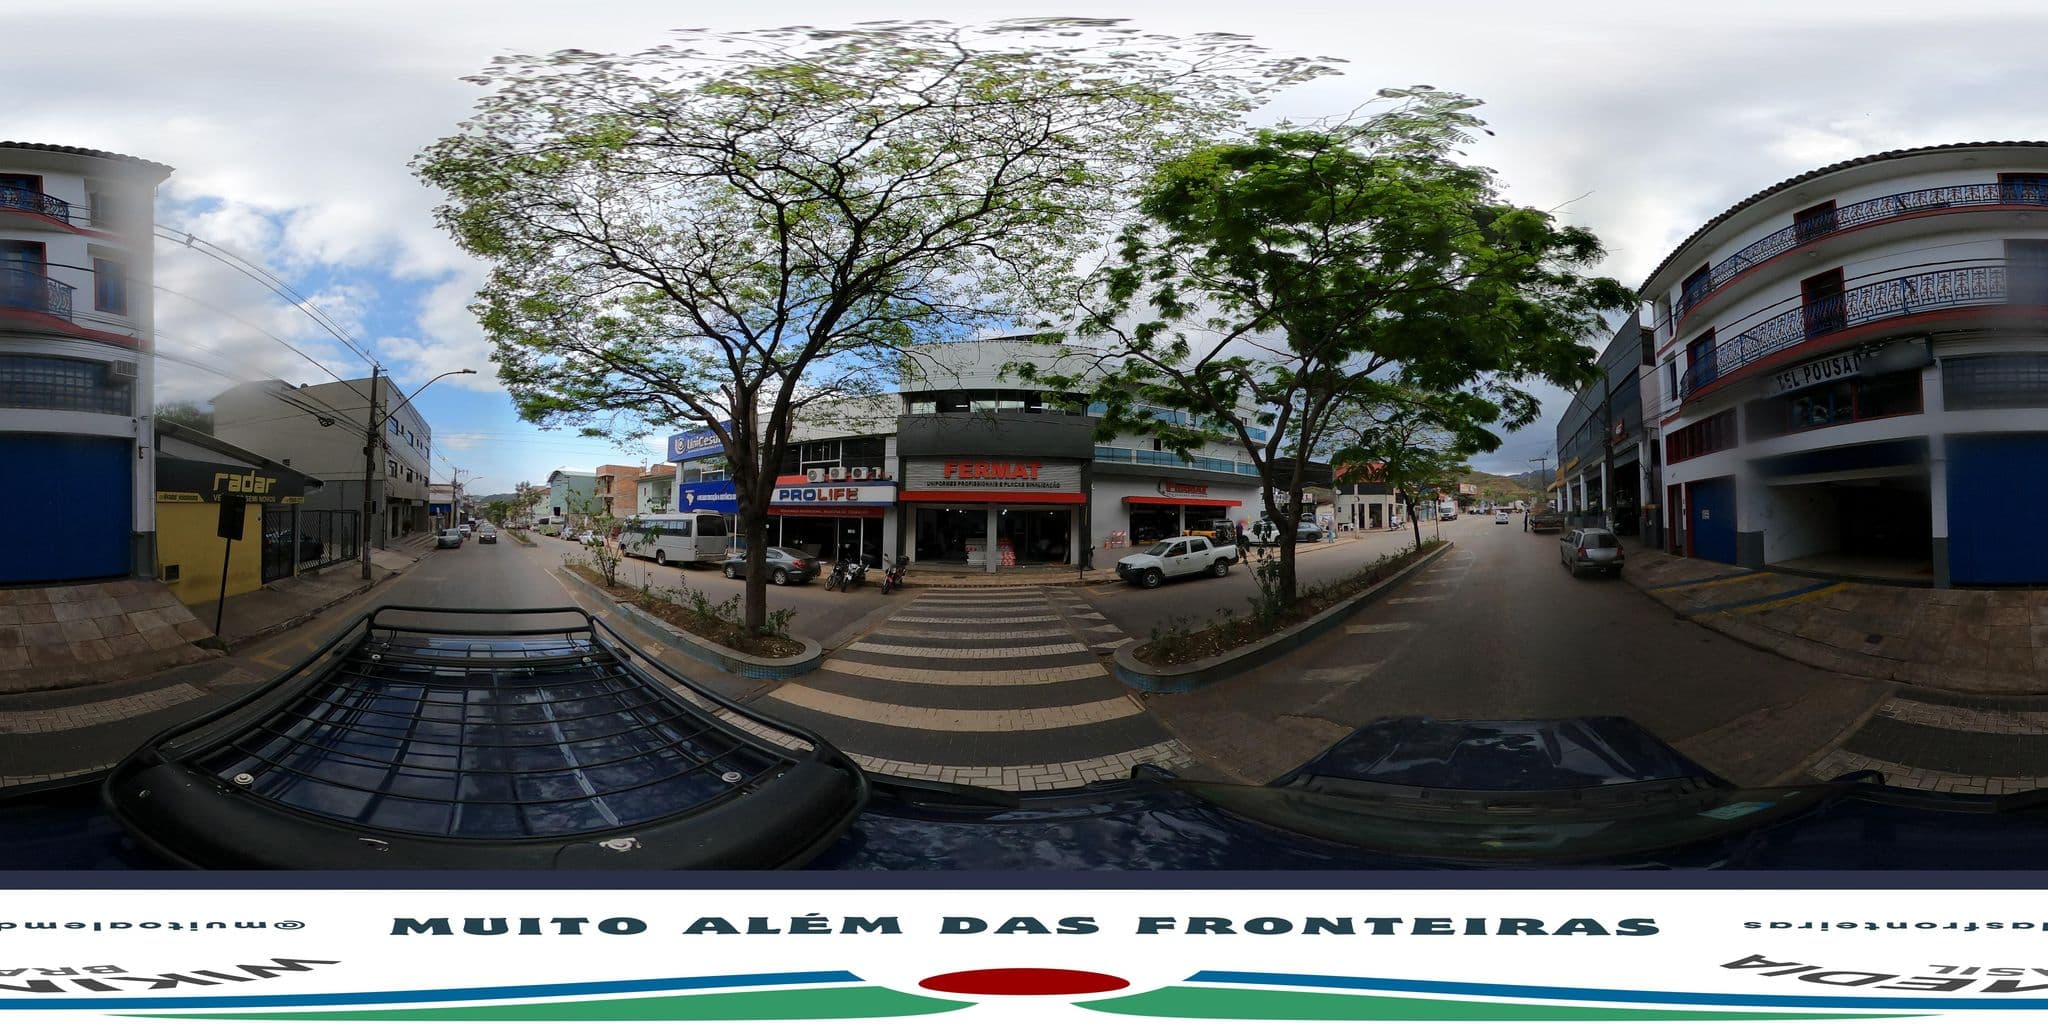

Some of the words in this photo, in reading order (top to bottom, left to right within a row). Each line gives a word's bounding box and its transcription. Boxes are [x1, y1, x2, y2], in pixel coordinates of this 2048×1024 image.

[944, 461, 1042, 480] FERMAT
[213, 470, 277, 494] radar
[779, 488, 859, 502] PROLIFE
